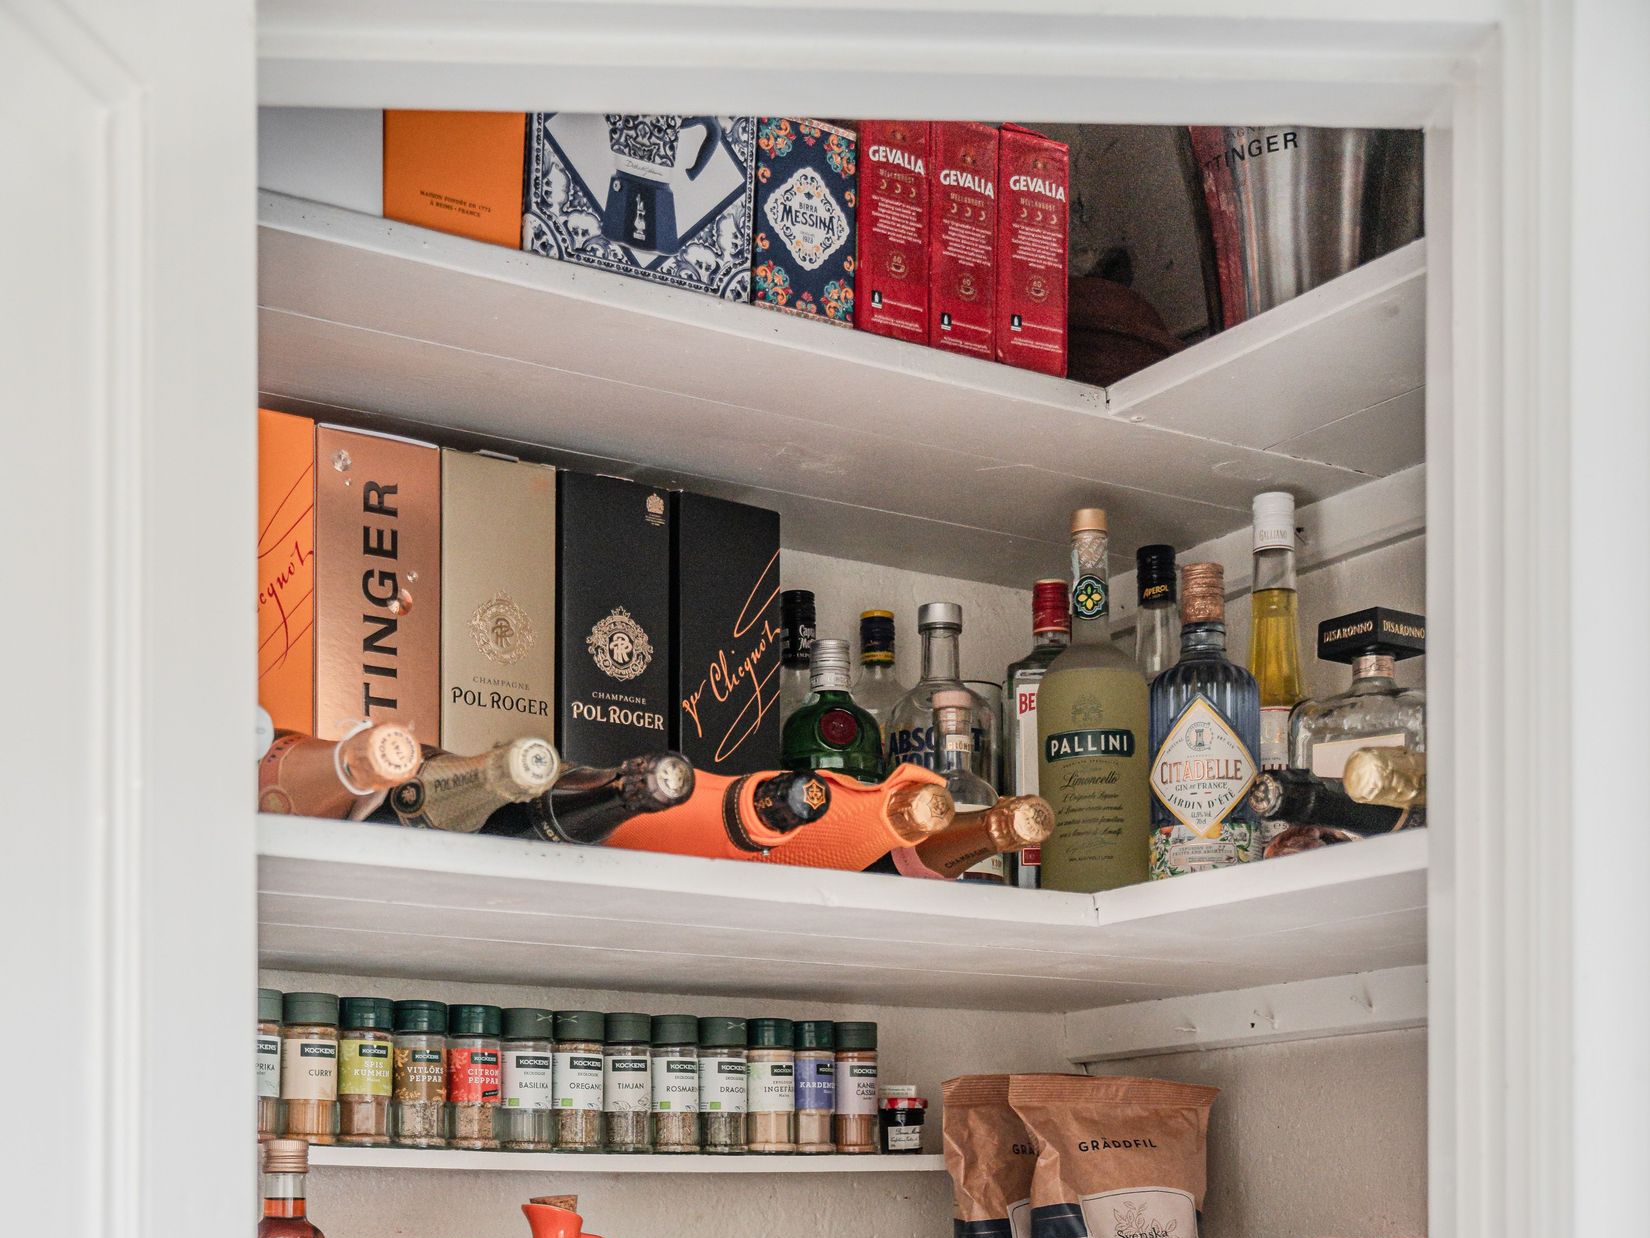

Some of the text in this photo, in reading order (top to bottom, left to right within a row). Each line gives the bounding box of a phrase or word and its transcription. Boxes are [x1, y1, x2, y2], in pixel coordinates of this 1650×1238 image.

[869, 145, 926, 176] GEVALIA
[940, 169, 995, 199] GEVALIA
[1009, 175, 1066, 202] GEVALIA
[799, 202, 818, 213] BIRRA
[780, 202, 836, 236] MESSINA
[362, 480, 399, 717] TINGER
[1143, 584, 1169, 599] APEROL
[1323, 620, 1373, 643] DISARONNO
[1383, 620, 1425, 640] DISARONNO
[473, 675, 530, 691] CHAMPAGNE
[451, 686, 548, 717] POL ROGER
[592, 691, 647, 705] CHAMPAGNE
[571, 701, 664, 731] POL ROGER
[1051, 734, 1127, 757] PALLINI
[1060, 770, 1118, 790] Limoncello
[1160, 758, 1243, 785] CITADELLE
[1175, 781, 1228, 792] GIN FRANCE
[1167, 793, 1202, 810] JARDIN
[304, 1047, 335, 1055] KOCKENS
[308, 1069, 332, 1077] CURRY
[364, 1060, 384, 1069] SPIS
[353, 1069, 390, 1078] KUMMIN
[519, 1081, 548, 1089] BASILIKA
[617, 1082, 645, 1090] TIMJAN
[1078, 1137, 1157, 1152] GRÄDDFIL
